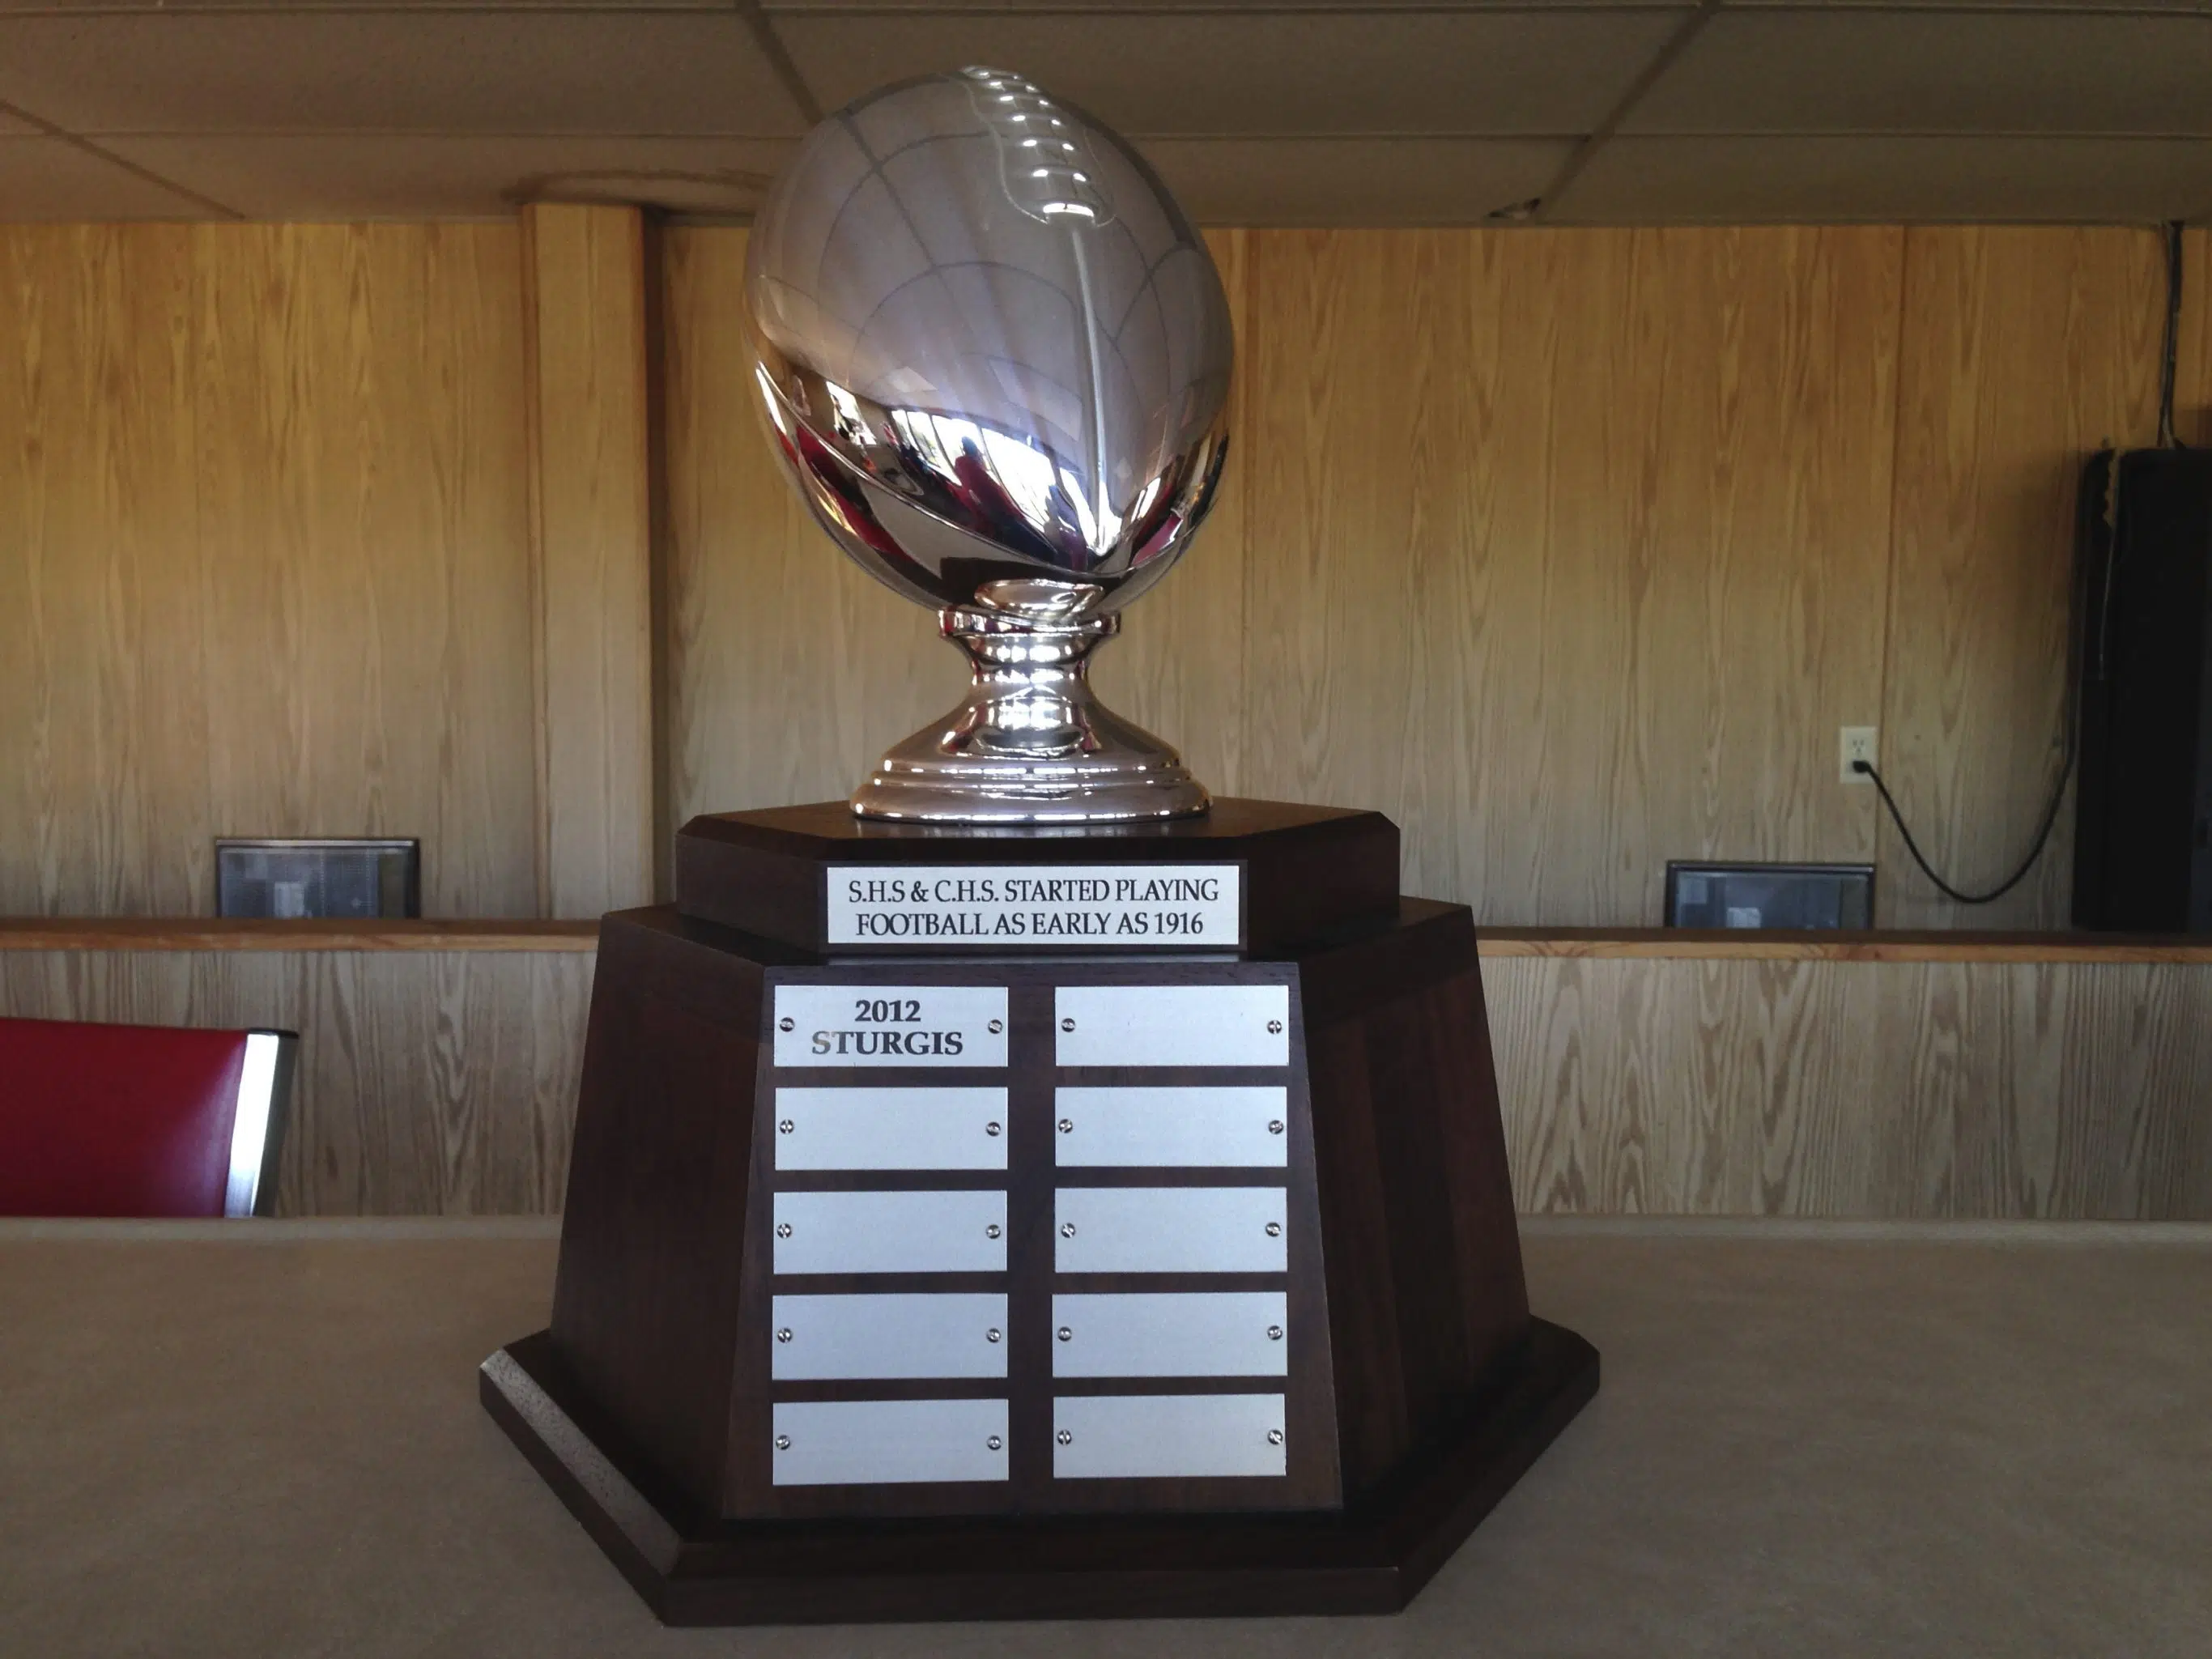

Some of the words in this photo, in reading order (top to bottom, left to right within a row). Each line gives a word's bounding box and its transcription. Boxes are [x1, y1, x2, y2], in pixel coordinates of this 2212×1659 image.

[849, 879, 905, 903] S.H.S
[911, 880, 929, 903] &
[934, 879, 999, 902] C.H.S.
[1004, 879, 1110, 902] STARTED
[1115, 878, 1219, 901] PLAYING
[856, 912, 989, 936] FOOTBALL
[993, 912, 1026, 935] AS
[1032, 912, 1112, 935] EARLY
[1116, 912, 1149, 934] AS
[1155, 912, 1204, 934] 1916
[854, 999, 921, 1023] 2012
[811, 1031, 963, 1056] STURGIS
